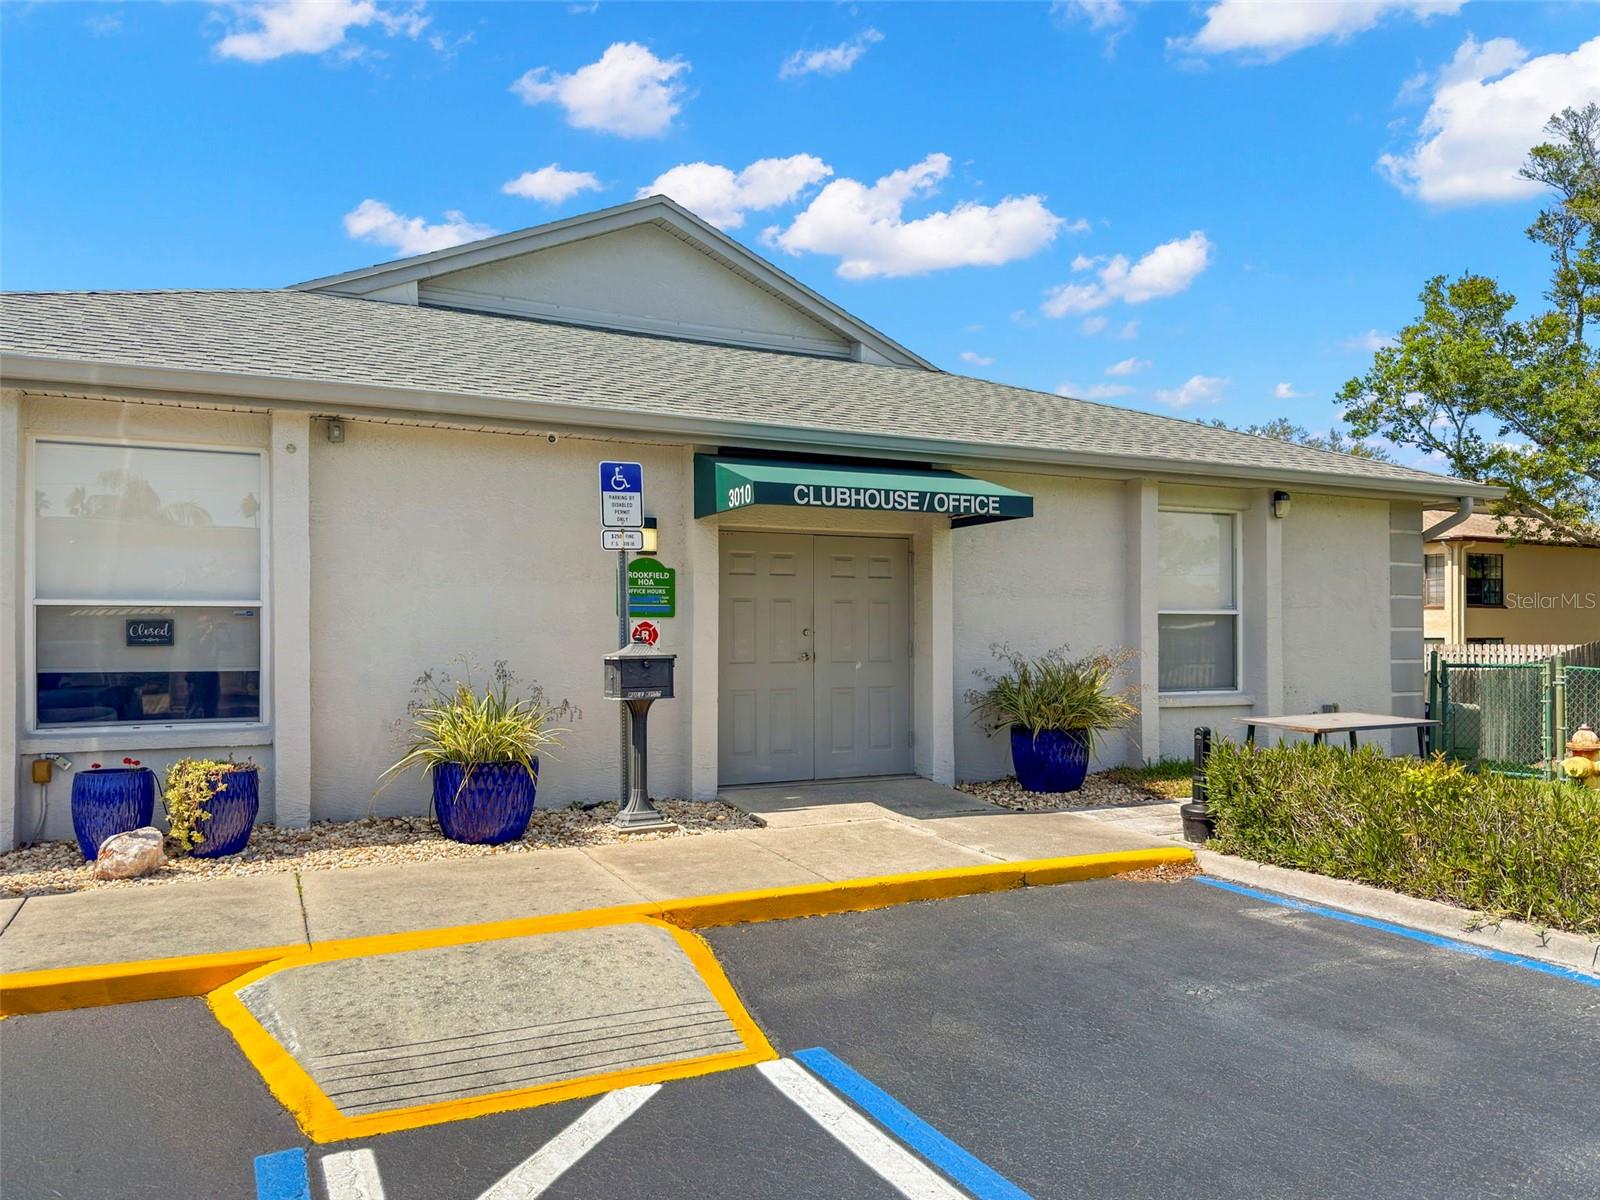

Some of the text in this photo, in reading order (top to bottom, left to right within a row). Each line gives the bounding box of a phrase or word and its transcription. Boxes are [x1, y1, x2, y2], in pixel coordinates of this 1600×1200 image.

[728, 483, 751, 508] 3010
[793, 485, 1000, 515] CLUBHOUSE / OFFICE
[628, 571, 670, 579] ROOKFIELD
[129, 623, 171, 637] Closed
[641, 630, 650, 640] R
